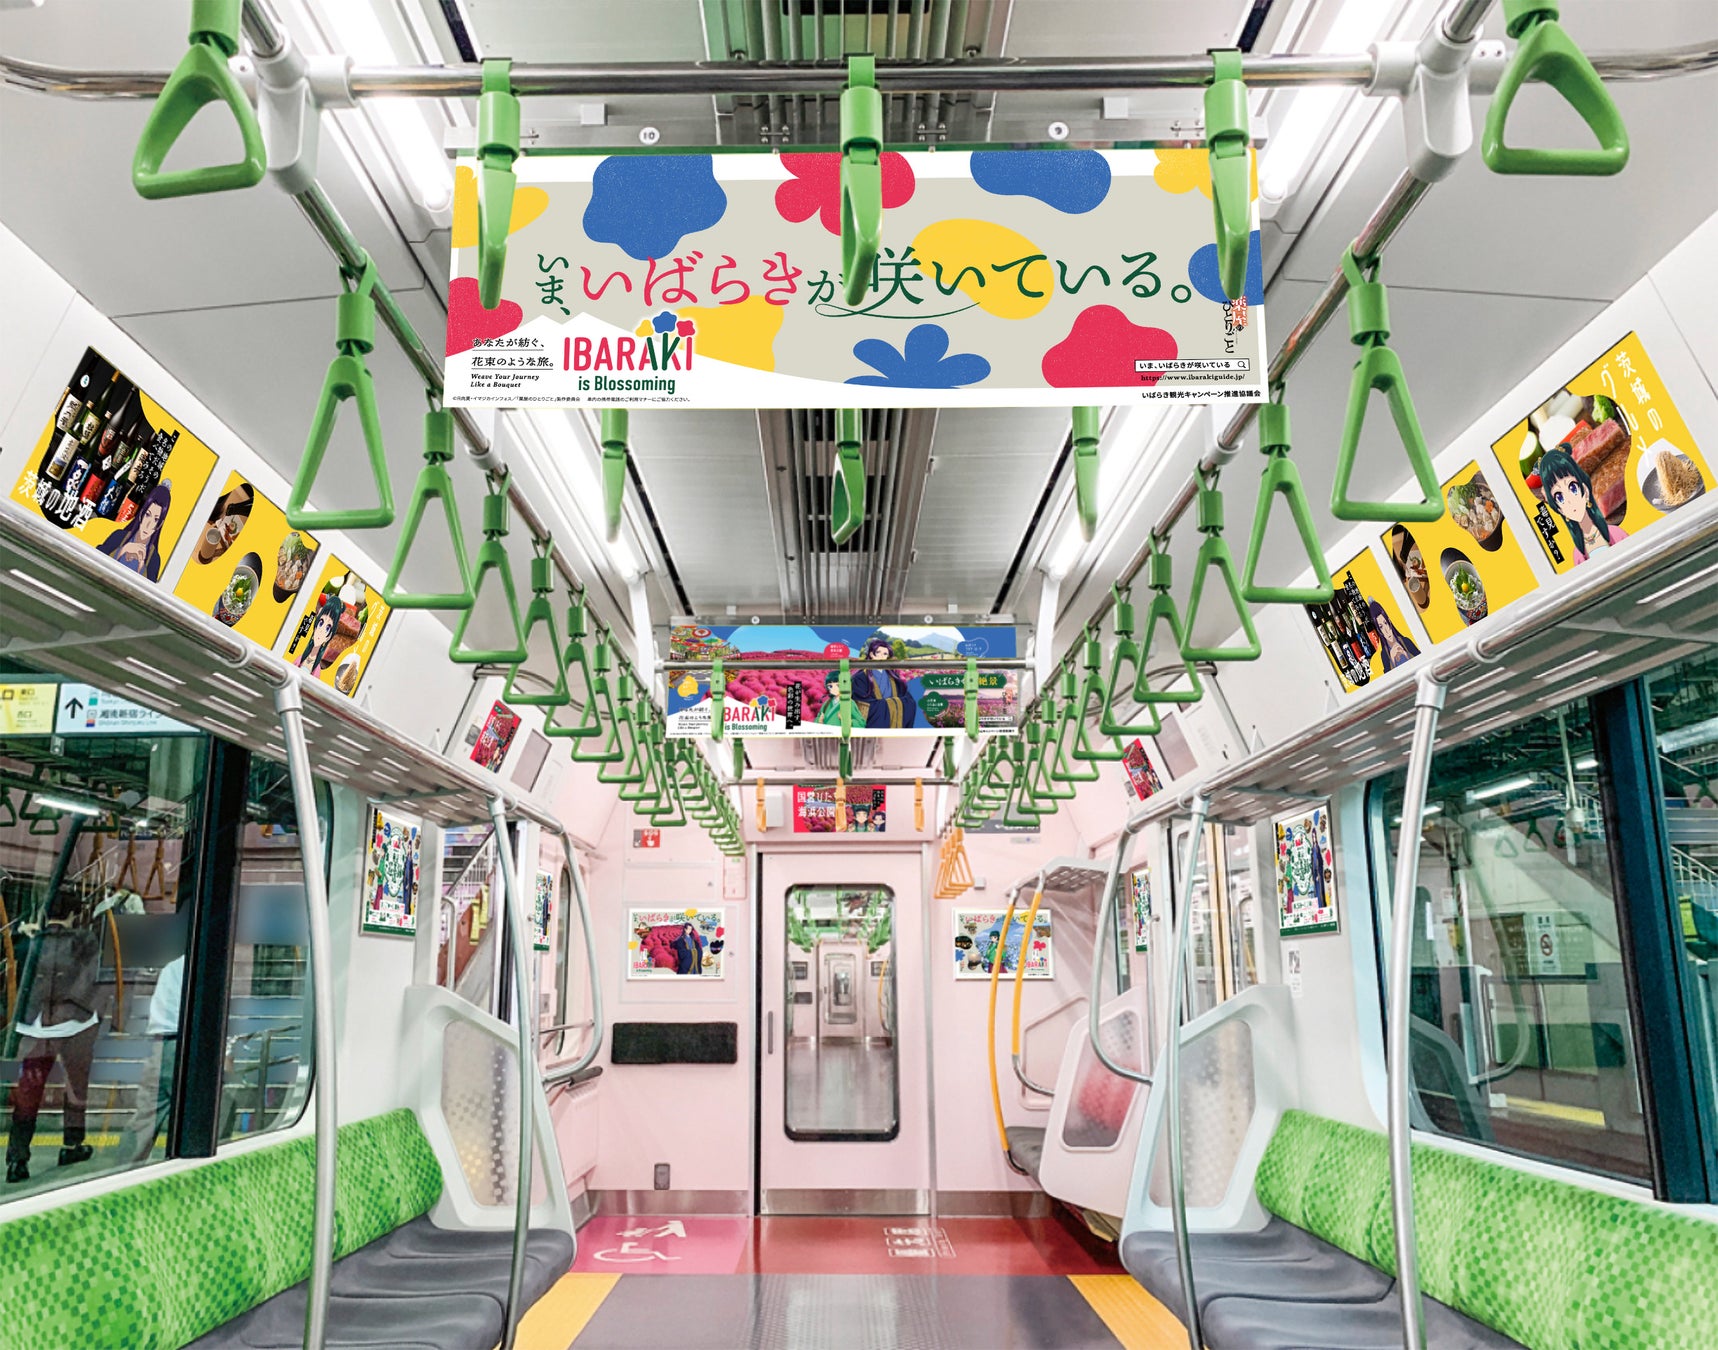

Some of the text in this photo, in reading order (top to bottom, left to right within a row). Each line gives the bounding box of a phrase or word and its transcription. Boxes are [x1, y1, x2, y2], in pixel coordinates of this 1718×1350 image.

[643, 131, 656, 140] 10
[535, 253, 570, 316] いま、
[472, 338, 545, 348] あなたが紡ぐ、
[563, 333, 692, 371] IBARAKI
[471, 356, 554, 367] 花束のような旅。
[1139, 361, 1231, 370] いま、いばらきが咲いている
[1140, 373, 1246, 382] https://www.ibarakiguide.jp/
[578, 375, 676, 395] is Blossoming
[1141, 390, 1262, 399] いばらき観光キャンペーン推進協議会
[1615, 350, 1663, 432] 茨城の
[17, 469, 97, 532] 茨城の地酒
[929, 676, 998, 686] いばらき絶景
[724, 705, 776, 722] BARAKI
[731, 723, 768, 732] Blossoming
